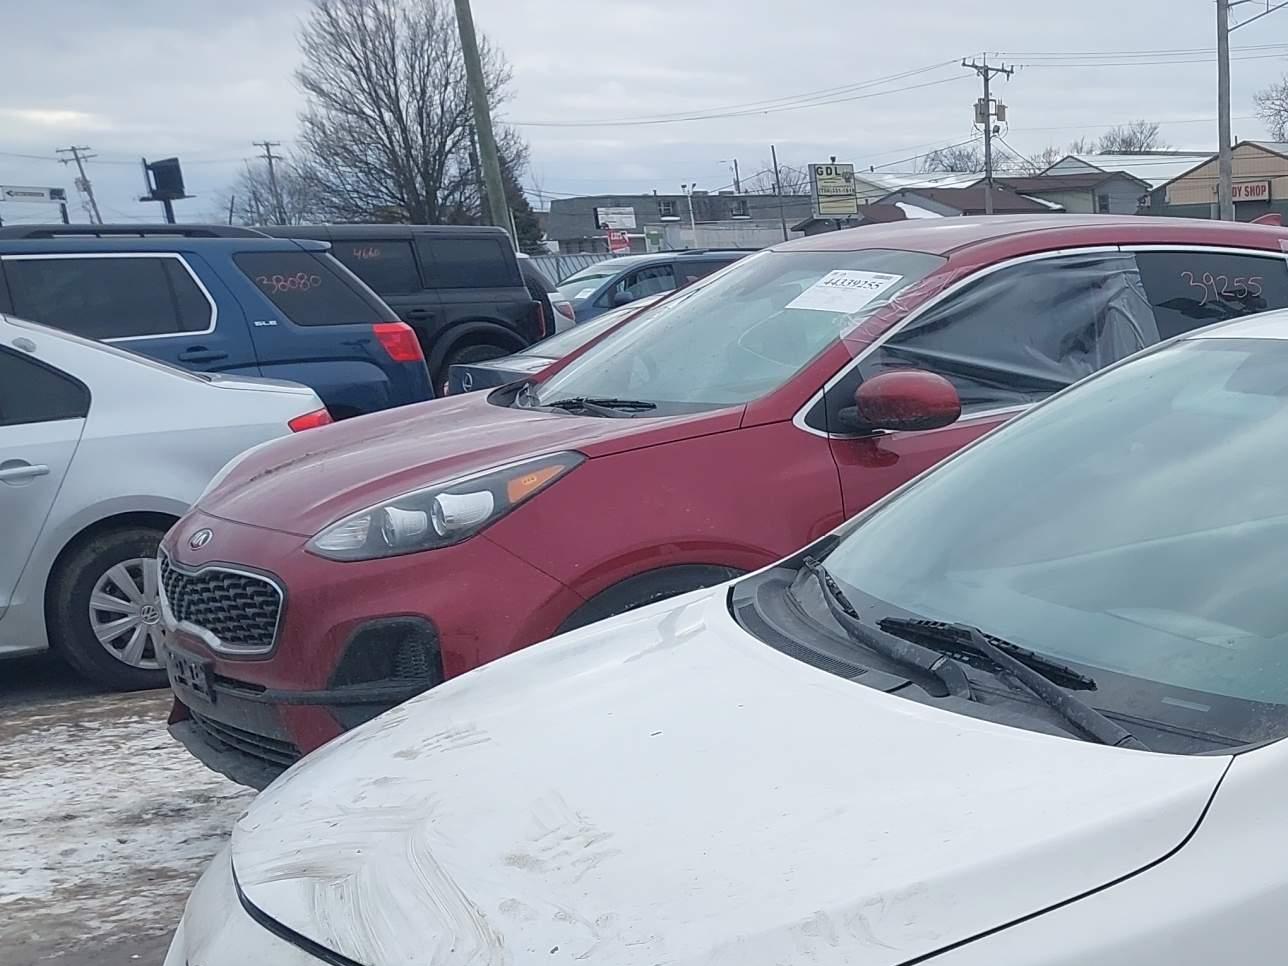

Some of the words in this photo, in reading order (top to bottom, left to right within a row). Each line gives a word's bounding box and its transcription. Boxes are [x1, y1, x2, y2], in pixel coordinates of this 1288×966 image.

[816, 166, 841, 176] GDL
[1244, 184, 1267, 197] SHOP
[256, 272, 321, 293] 38080
[1180, 271, 1264, 306] 39255
